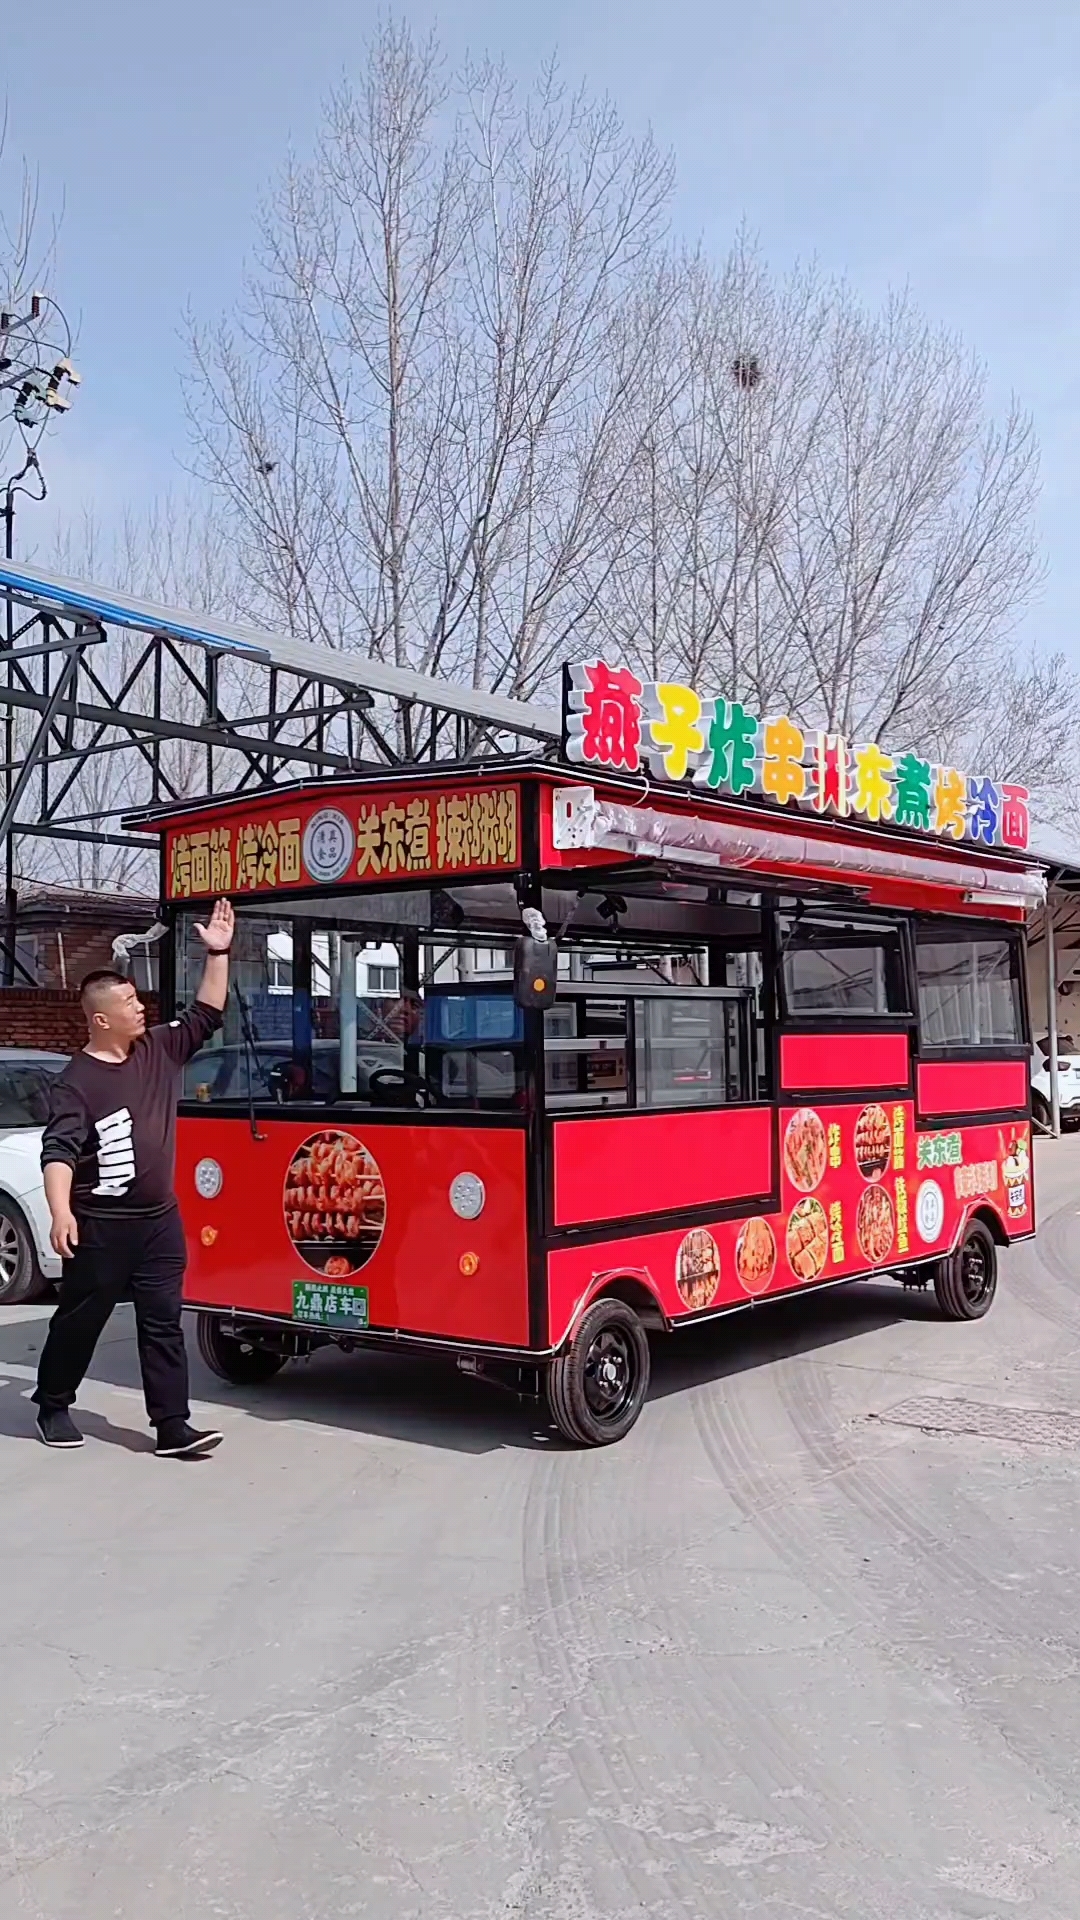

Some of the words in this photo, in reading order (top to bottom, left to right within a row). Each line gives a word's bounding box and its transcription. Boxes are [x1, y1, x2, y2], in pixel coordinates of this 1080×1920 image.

[171, 827, 232, 898] 烤面筋
[236, 818, 300, 889] 烤冷面
[357, 798, 431, 876] 关东煮
[917, 1131, 963, 1170] 关东煮
